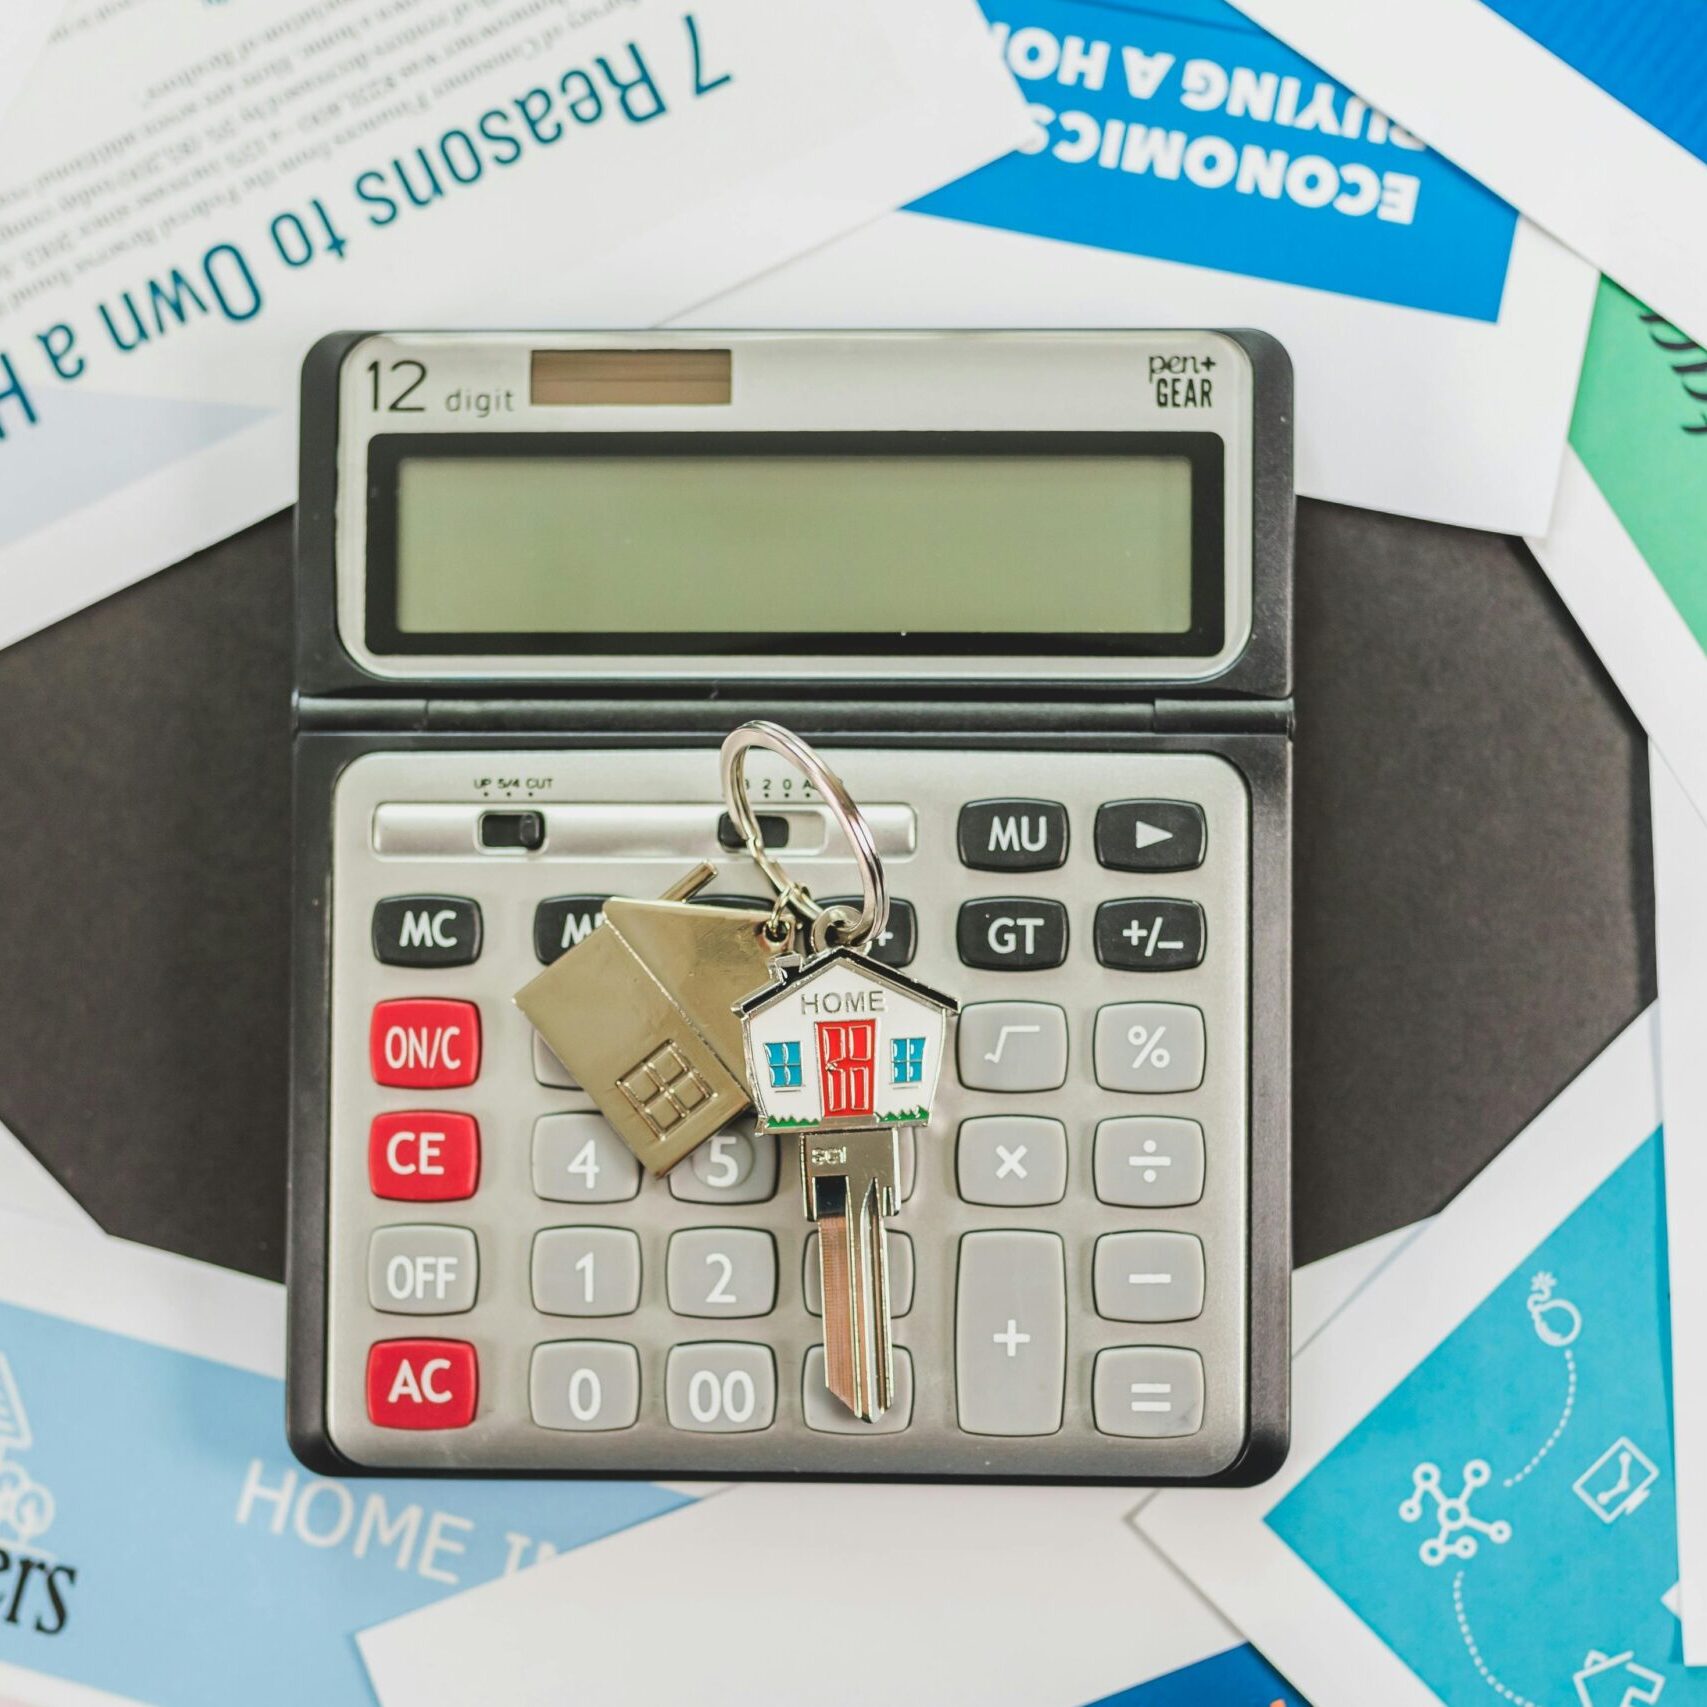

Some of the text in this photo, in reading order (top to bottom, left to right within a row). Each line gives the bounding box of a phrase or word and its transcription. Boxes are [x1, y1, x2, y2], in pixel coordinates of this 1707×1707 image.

[683, 14, 733, 97] 7
[1120, 45, 1176, 100] A
[1180, 58, 1426, 152] UYING
[355, 41, 668, 226] Reasons
[1016, 103, 1421, 226] ECONOMICS
[270, 198, 348, 268] to
[97, 244, 262, 352] Own
[35, 323, 85, 380] a
[367, 360, 515, 418] 12 digit
[1156, 378, 1212, 408] GEAR
[474, 779, 553, 789] UP 5/4 CUT
[763, 779, 771, 790] 2
[987, 815, 1048, 852] MU
[400, 909, 458, 947] MC
[987, 917, 1045, 954] GT
[800, 990, 885, 1015] HOME
[384, 1026, 461, 1069] ON/C
[1127, 1025, 1170, 1069] %
[386, 1132, 444, 1175] CE
[567, 1139, 599, 1188] 4
[706, 1137, 739, 1187] 5
[387, 1255, 457, 1299] OFF
[574, 1252, 595, 1302] 1
[705, 1253, 736, 1303] 2
[388, 1358, 453, 1404] AC
[568, 1368, 600, 1421] 0
[688, 1370, 755, 1422] 00
[234, 1457, 476, 1585] HOME
